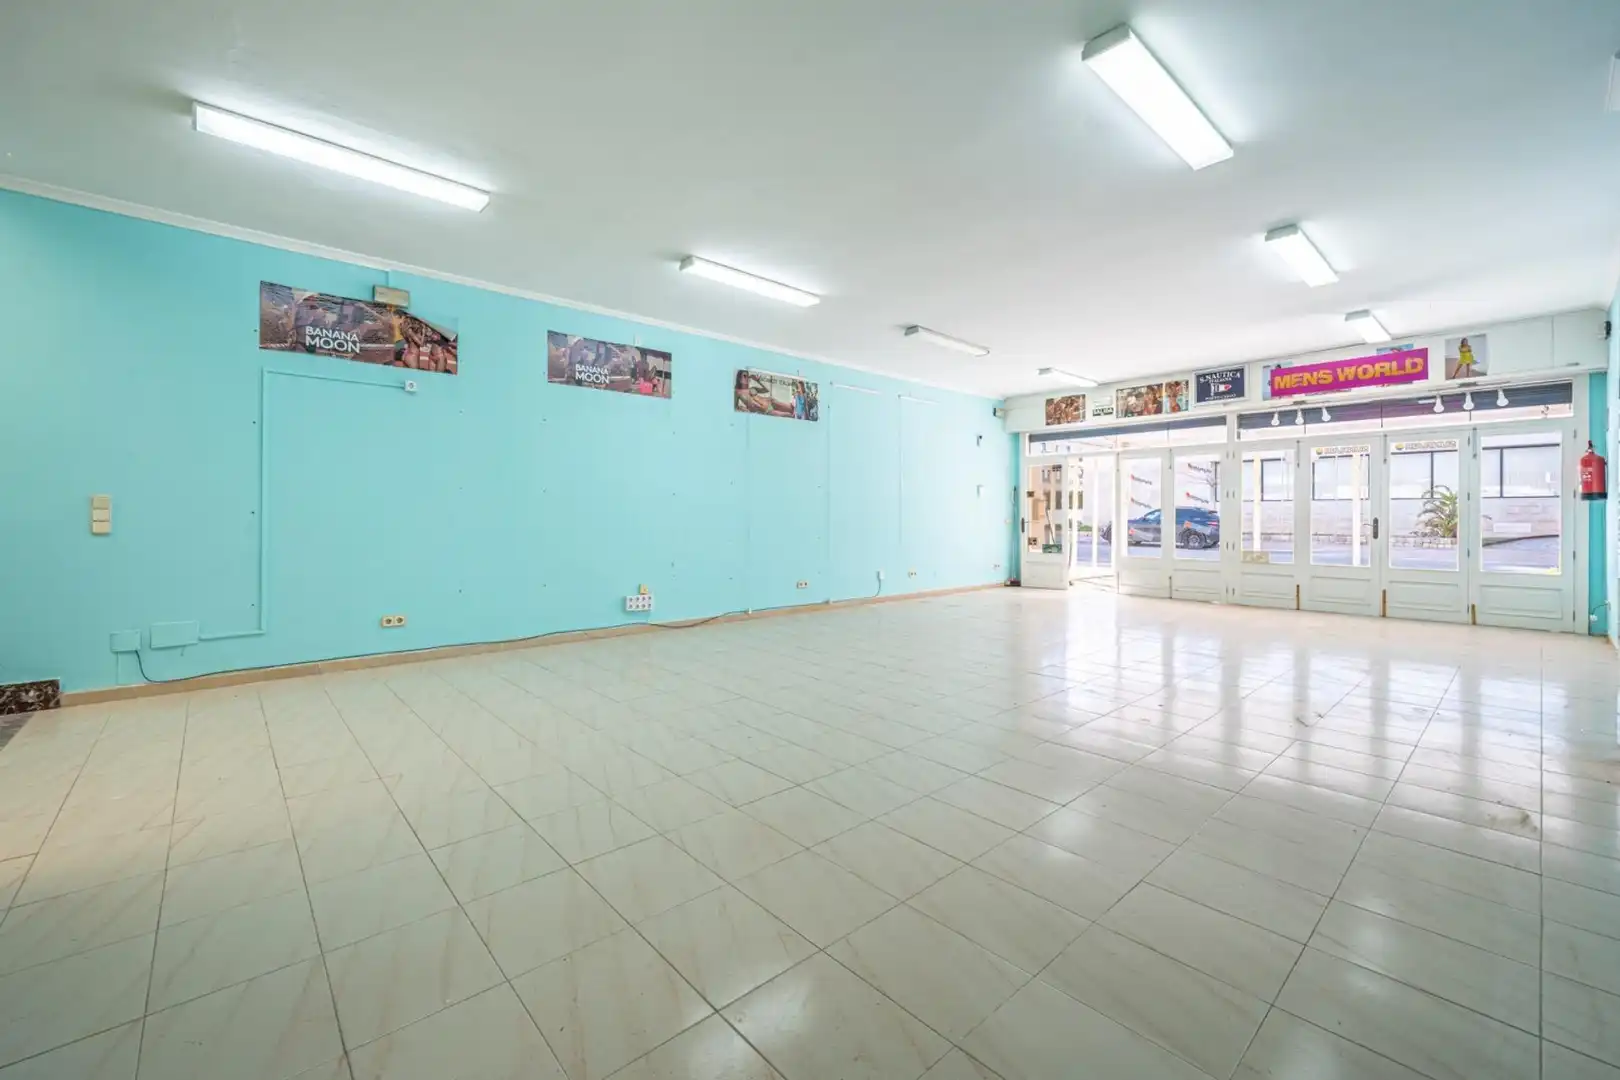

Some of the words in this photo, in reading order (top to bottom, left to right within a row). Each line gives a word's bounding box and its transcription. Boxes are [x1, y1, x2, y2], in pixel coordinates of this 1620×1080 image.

[305, 326, 359, 342] BANANA
[305, 335, 360, 353] MOON
[575, 363, 609, 375] BANANA
[1274, 369, 1333, 390] MENS
[1337, 357, 1424, 382] WORLD
[575, 372, 610, 384] MOON
